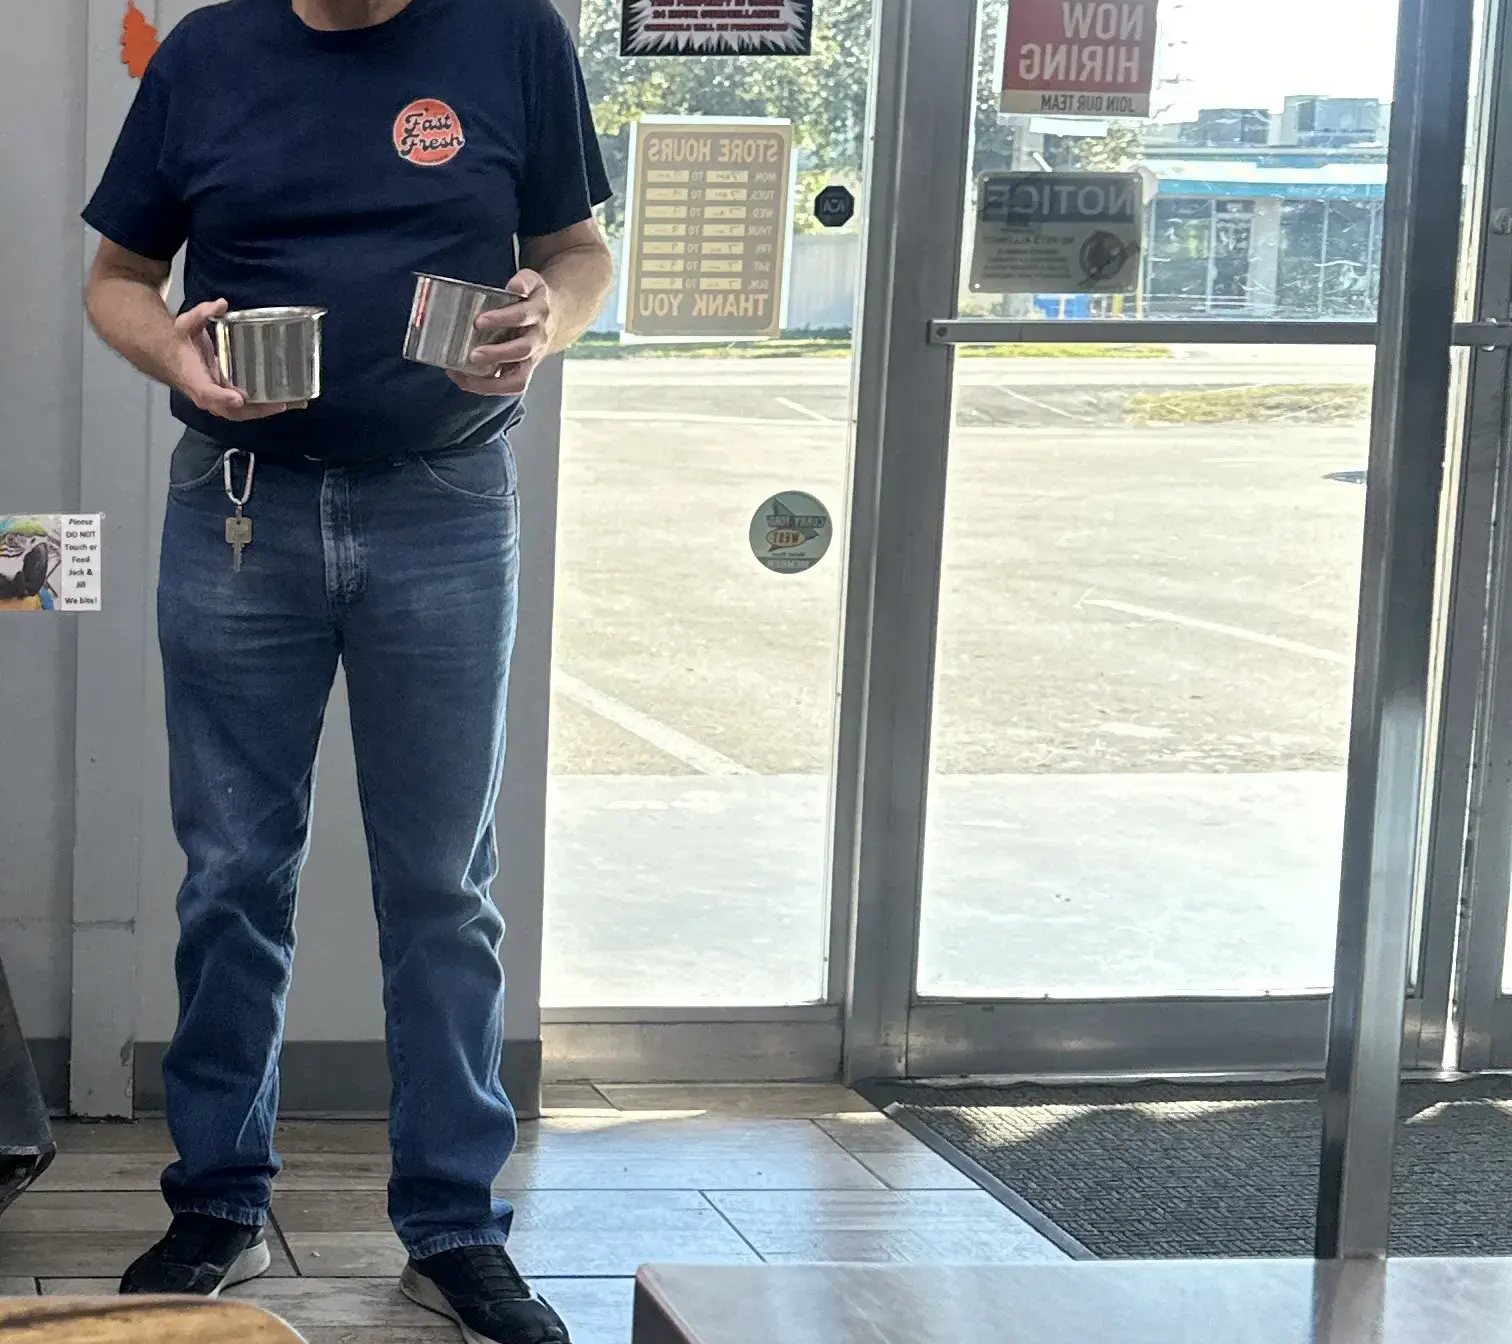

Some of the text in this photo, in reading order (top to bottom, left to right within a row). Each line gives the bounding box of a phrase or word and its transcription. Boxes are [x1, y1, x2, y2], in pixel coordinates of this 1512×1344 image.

[404, 113, 452, 133] Fast
[401, 132, 464, 156] Fresh
[69, 518, 93, 526] Please
[86, 568, 93, 576] &
